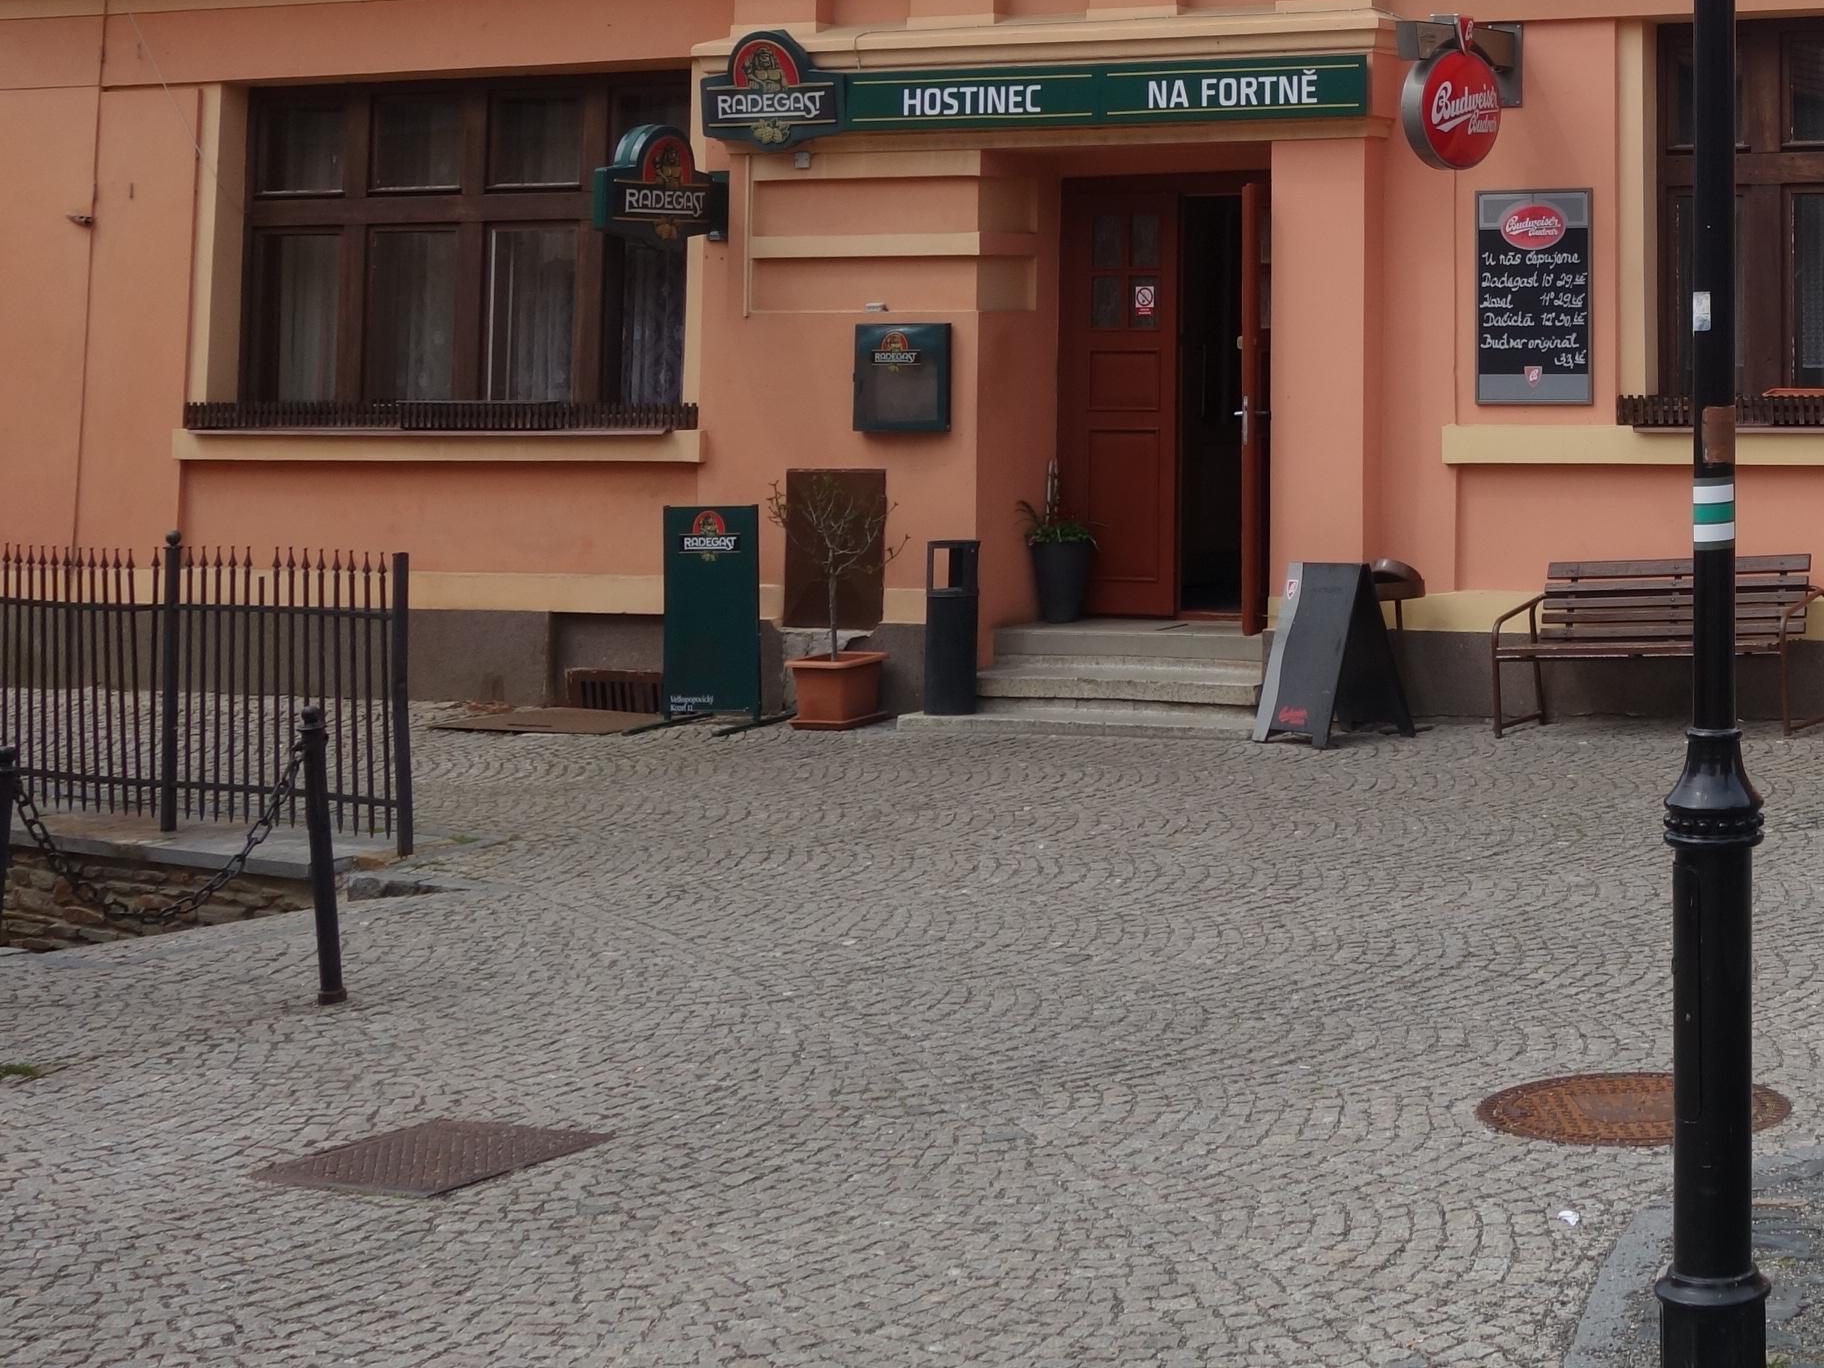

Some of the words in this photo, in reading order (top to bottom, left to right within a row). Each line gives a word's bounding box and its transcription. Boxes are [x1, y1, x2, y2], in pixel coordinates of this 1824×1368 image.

[903, 85, 1042, 116] HOSTINEC
[1148, 80, 1189, 109] NA
[1201, 69, 1318, 107] FORTNĚ
[1431, 81, 1499, 125] Budweiser
[717, 90, 825, 119] RADEGAST
[625, 189, 706, 217] RADEGAST
[1505, 215, 1561, 234] Budweiser
[1482, 252, 1496, 265] U
[874, 352, 917, 363] RADEGAST
[684, 537, 737, 550] RADEGAST
